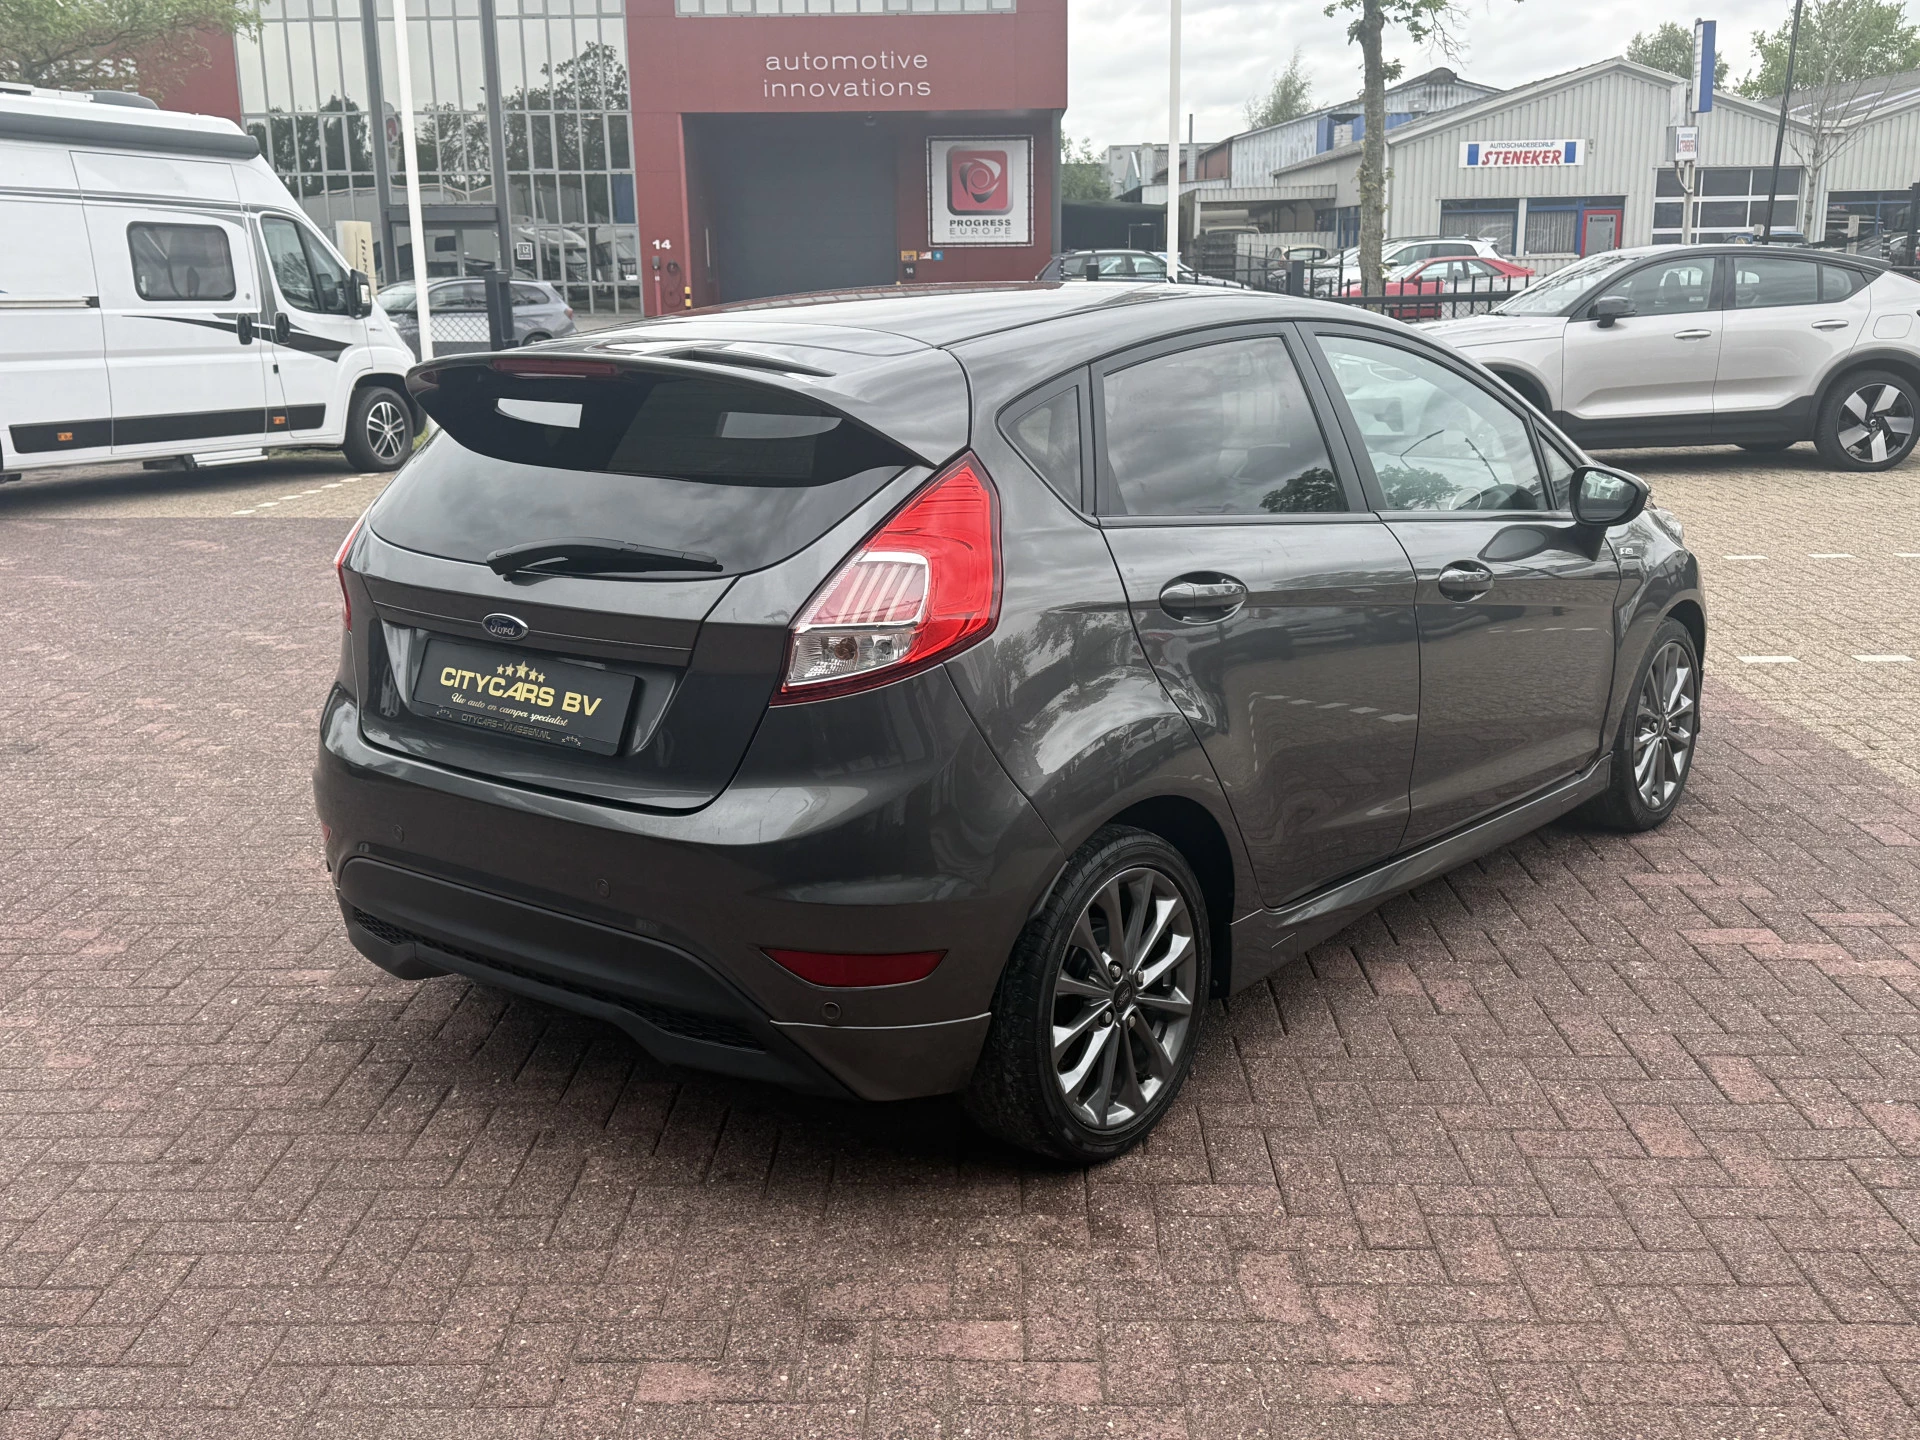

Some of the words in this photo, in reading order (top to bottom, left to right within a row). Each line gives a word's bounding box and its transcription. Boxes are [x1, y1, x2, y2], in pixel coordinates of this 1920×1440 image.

[765, 50, 928, 71] automotive
[763, 78, 931, 98] innovations
[1481, 150, 1562, 166] STENEKER
[949, 219, 1012, 227] PROGRESS
[949, 226, 1012, 235] EUROPE
[652, 239, 672, 250] 14
[490, 618, 516, 636] Ford
[440, 667, 556, 707] CITYCARS
[561, 691, 603, 716] BV
[451, 692, 467, 704] Uw
[467, 700, 486, 709] auto
[499, 706, 529, 718] camper
[529, 713, 569, 727] specialist
